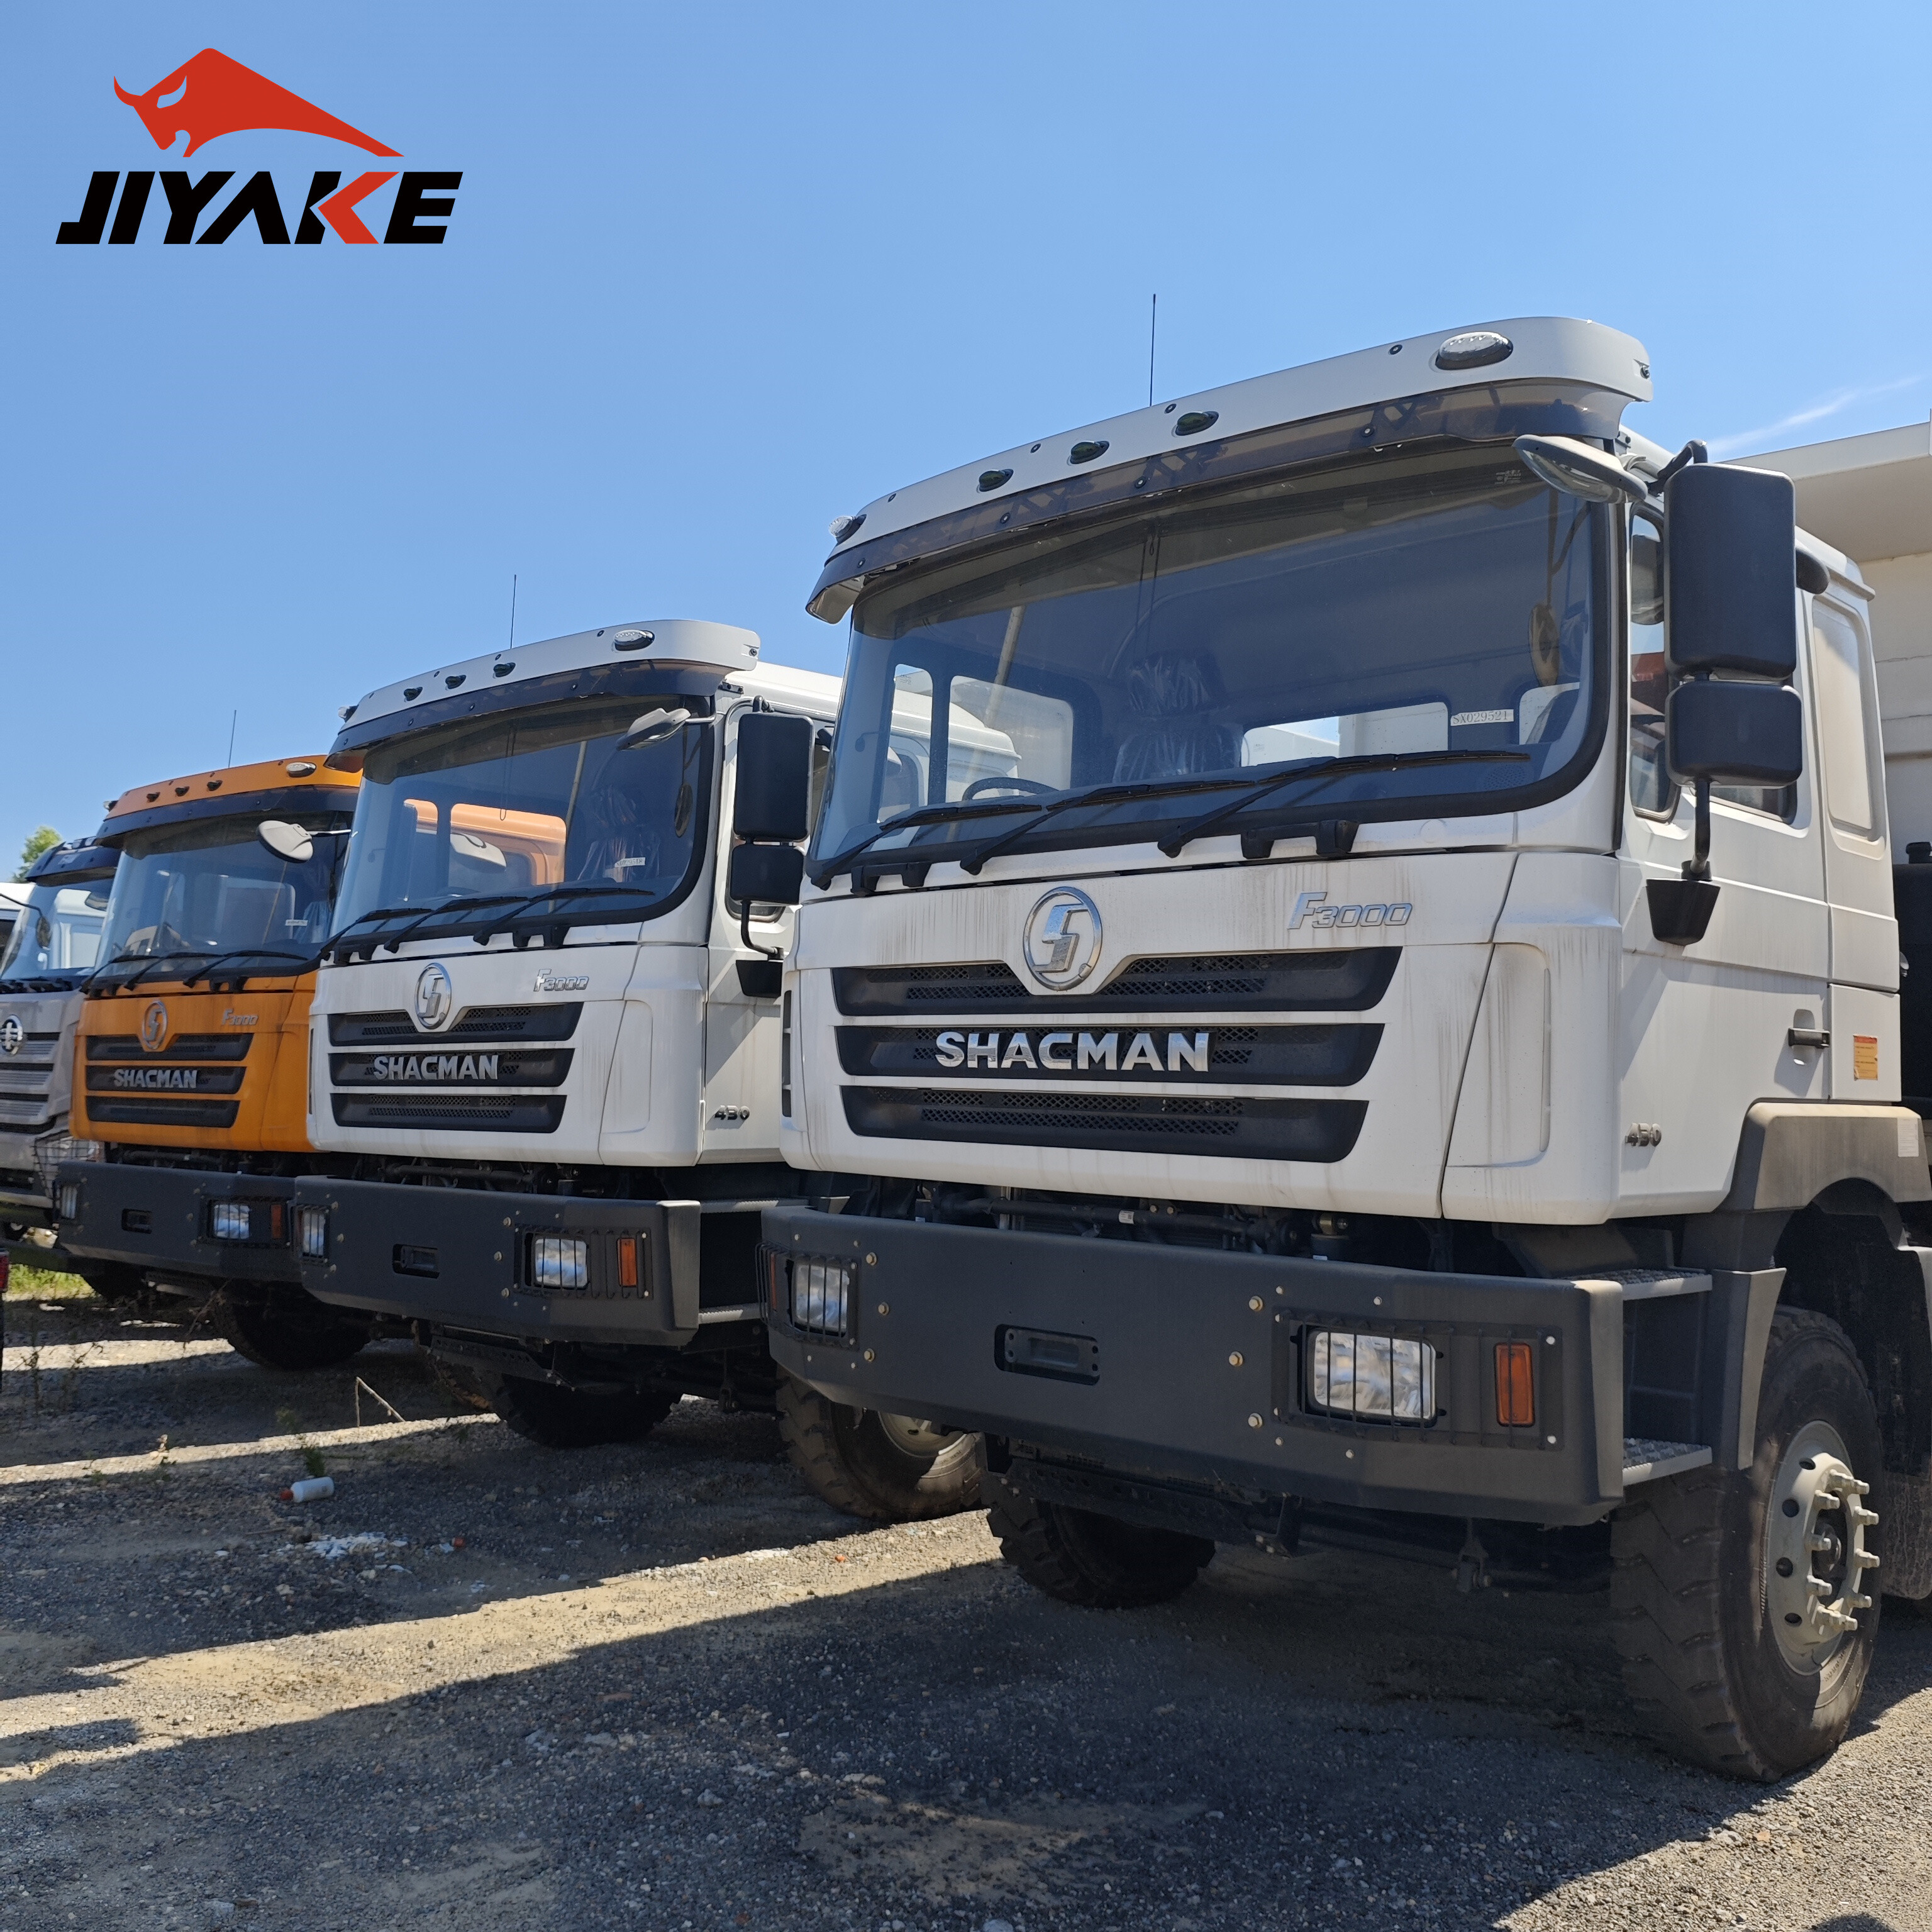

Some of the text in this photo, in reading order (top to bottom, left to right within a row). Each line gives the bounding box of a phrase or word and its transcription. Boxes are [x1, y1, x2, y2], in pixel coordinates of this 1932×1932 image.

[1453, 710, 1508, 724] SX029521
[1287, 891, 1413, 930] F3000
[533, 969, 589, 992] F3000
[935, 1031, 1209, 1072] SHACMAN
[113, 1069, 197, 1089] SHACMAN
[374, 1055, 499, 1080] SHACMAN
[714, 1104, 750, 1120] 430
[1624, 1123, 1662, 1147] 430
